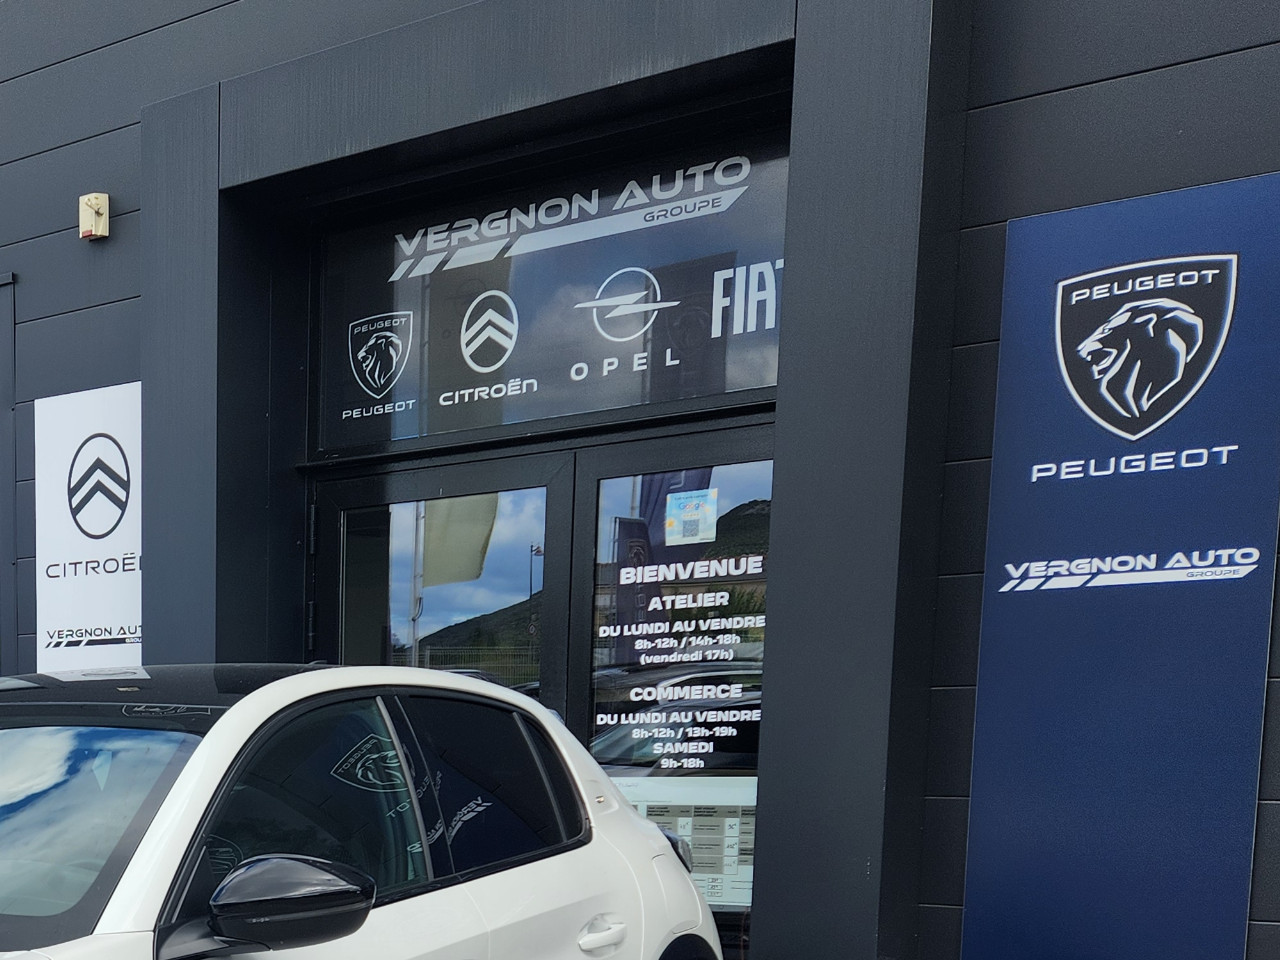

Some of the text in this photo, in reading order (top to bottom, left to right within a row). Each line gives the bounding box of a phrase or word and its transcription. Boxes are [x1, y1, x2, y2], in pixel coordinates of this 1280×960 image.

[395, 156, 751, 256] VERGNON AUTO
[643, 198, 723, 223] GROUPE
[1072, 270, 1220, 305] PEUGEOT
[711, 259, 785, 339] FIA
[353, 317, 407, 334] PEUGEOT
[570, 348, 680, 381] OPEL
[342, 399, 416, 420] PEUGEOT
[1031, 445, 1238, 482] PEUGEOT
[46, 552, 142, 578] CITROË
[620, 556, 763, 585] BIENVENUE
[1005, 547, 1260, 578] VERGNON AUTO
[1186, 568, 1241, 579] GROUPE
[648, 591, 730, 612] ATELIER
[47, 626, 112, 640] VERGNON
[598, 615, 766, 638] DU LUNDI AU VENDRE
[634, 636, 679, 650] 8h-12h
[688, 633, 741, 647] 14h-18h
[639, 648, 734, 666] (vendredi 17h)
[629, 684, 743, 702] COMMERCE
[596, 709, 762, 726] DU LUNDI AU VENDRE
[631, 726, 676, 739] 8h-12h
[685, 726, 738, 738] 13h-19h
[653, 741, 714, 754] SAMEDI
[660, 757, 705, 769] 9h-18h
